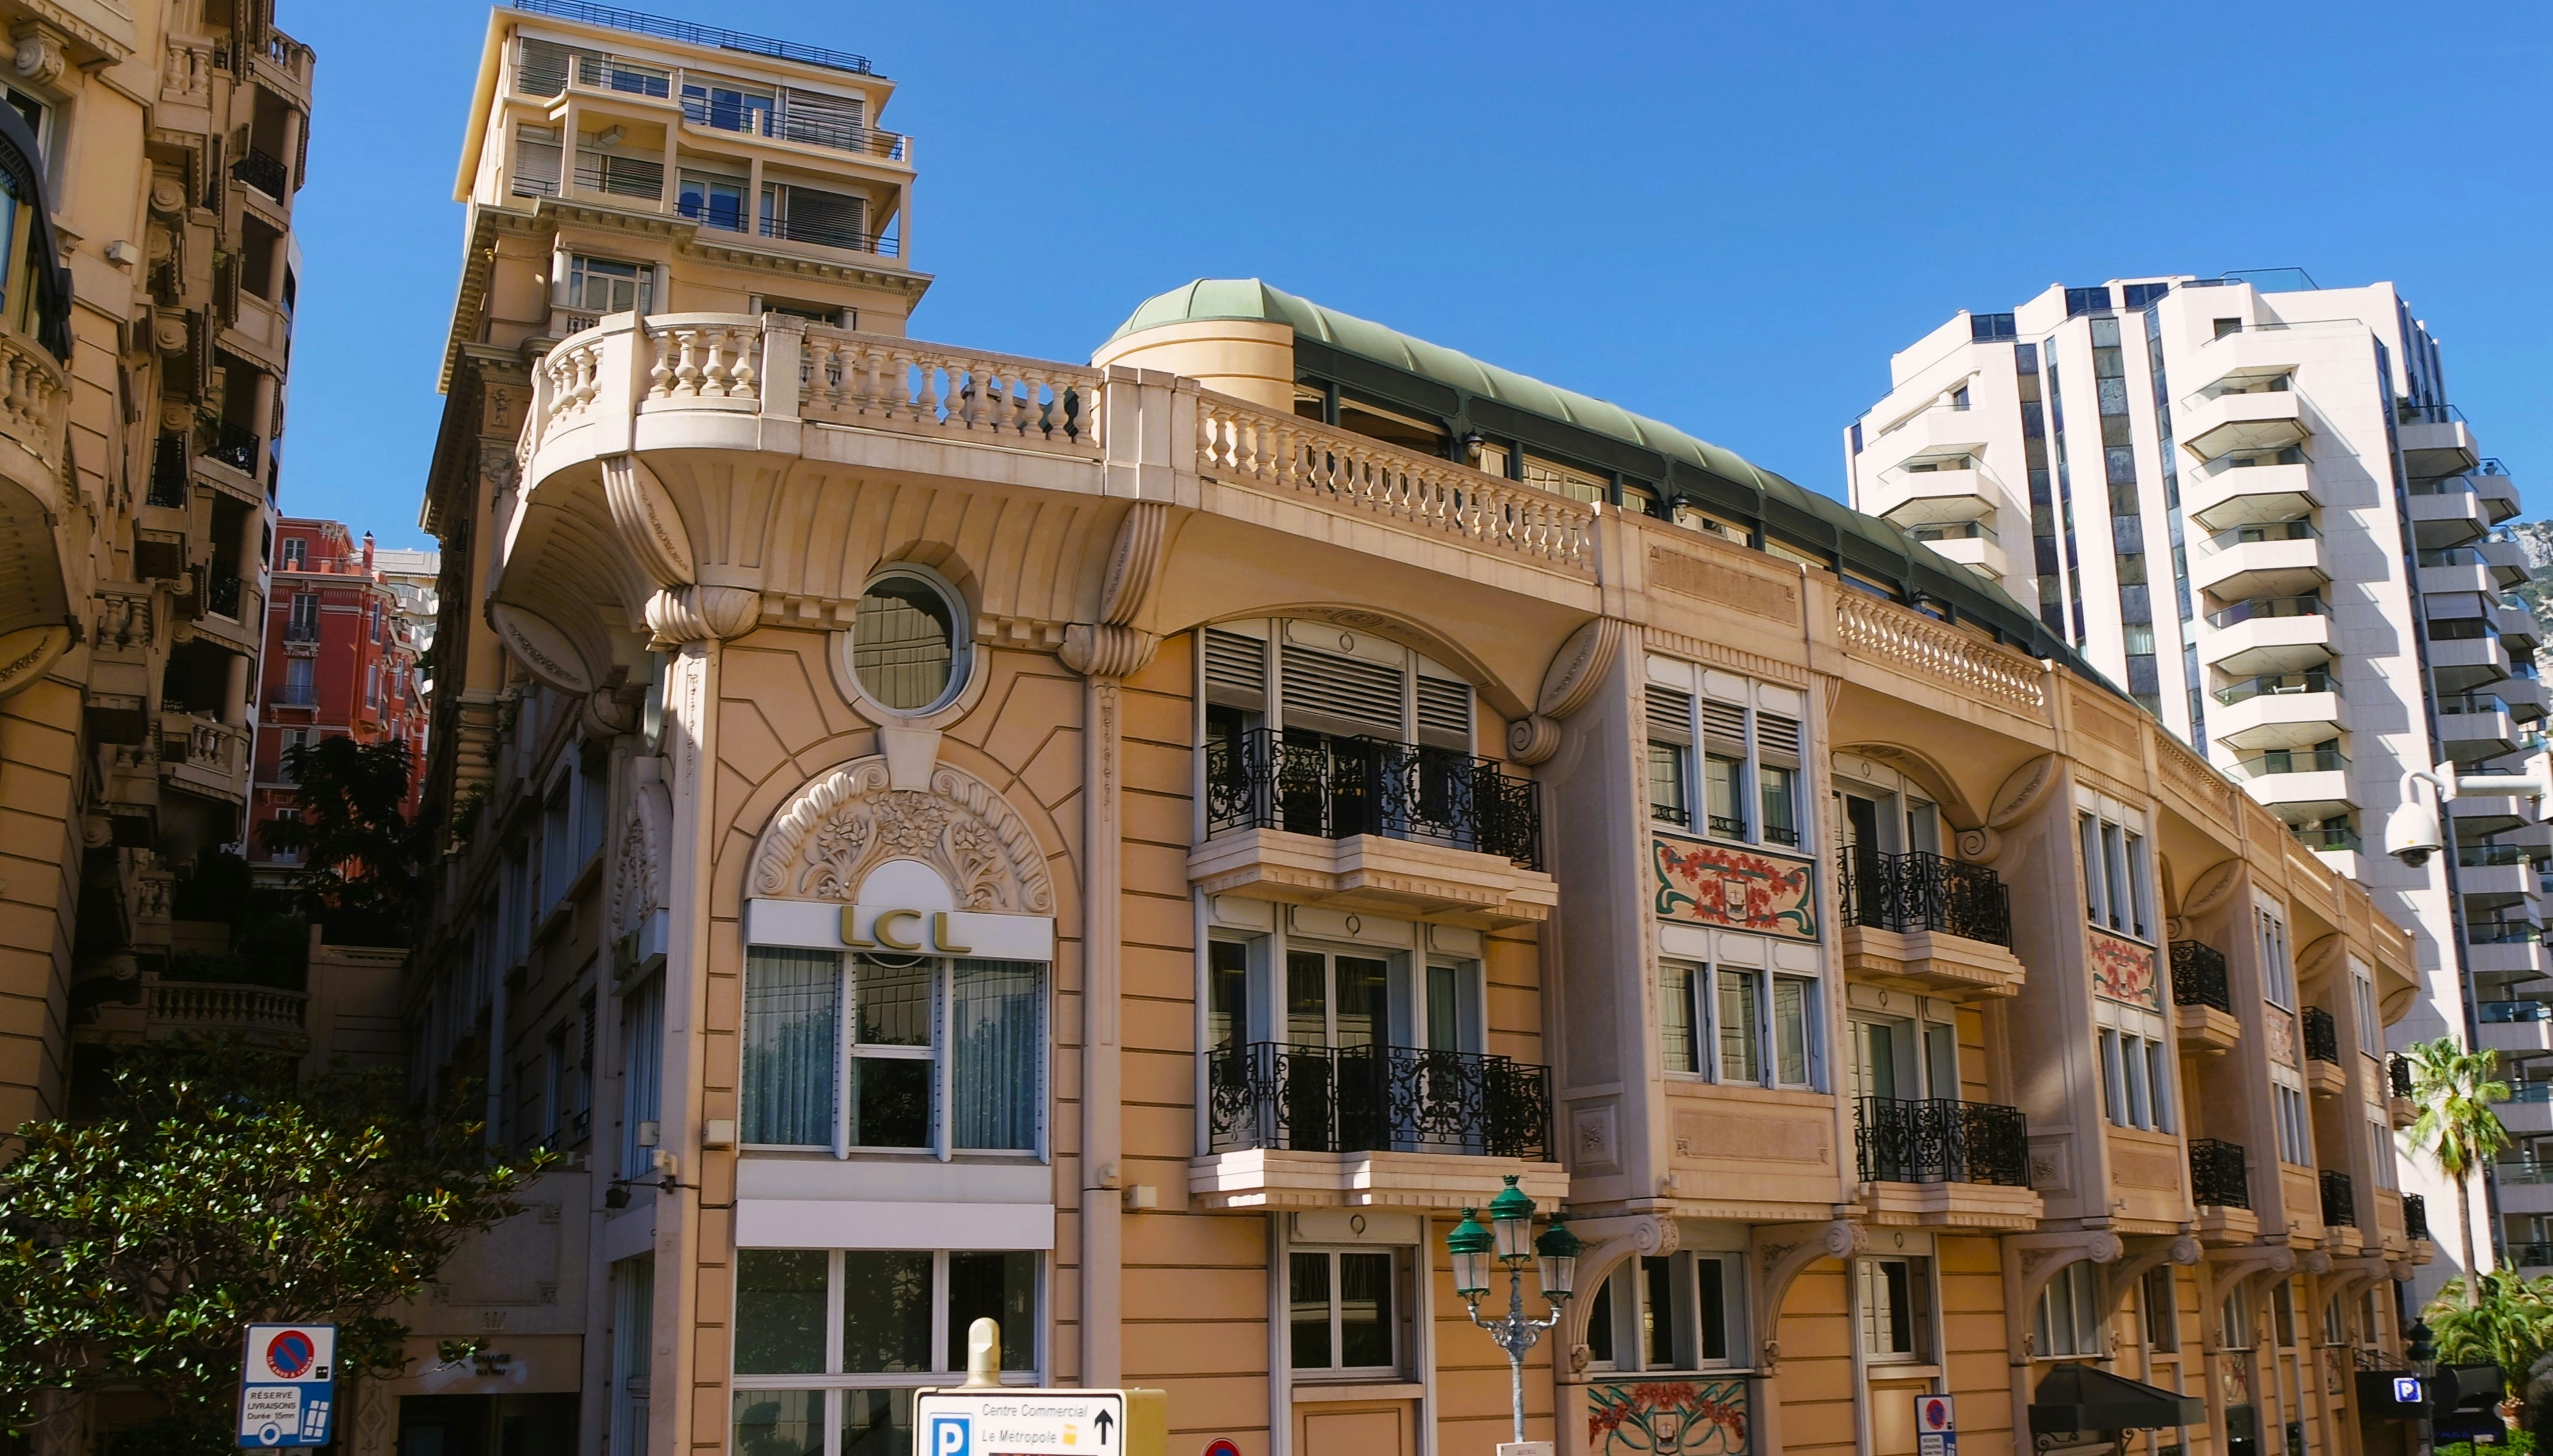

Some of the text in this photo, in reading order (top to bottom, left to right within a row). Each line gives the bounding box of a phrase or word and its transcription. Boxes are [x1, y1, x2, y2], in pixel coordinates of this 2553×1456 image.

[840, 905, 972, 953] LCL
[250, 1391, 293, 1399] RÉSERVÉ
[2401, 1383, 2414, 1397] P
[982, 1404, 1088, 1417] Centre Commercial
[938, 1423, 964, 1456] P
[982, 1429, 1057, 1446] Le Métropole
